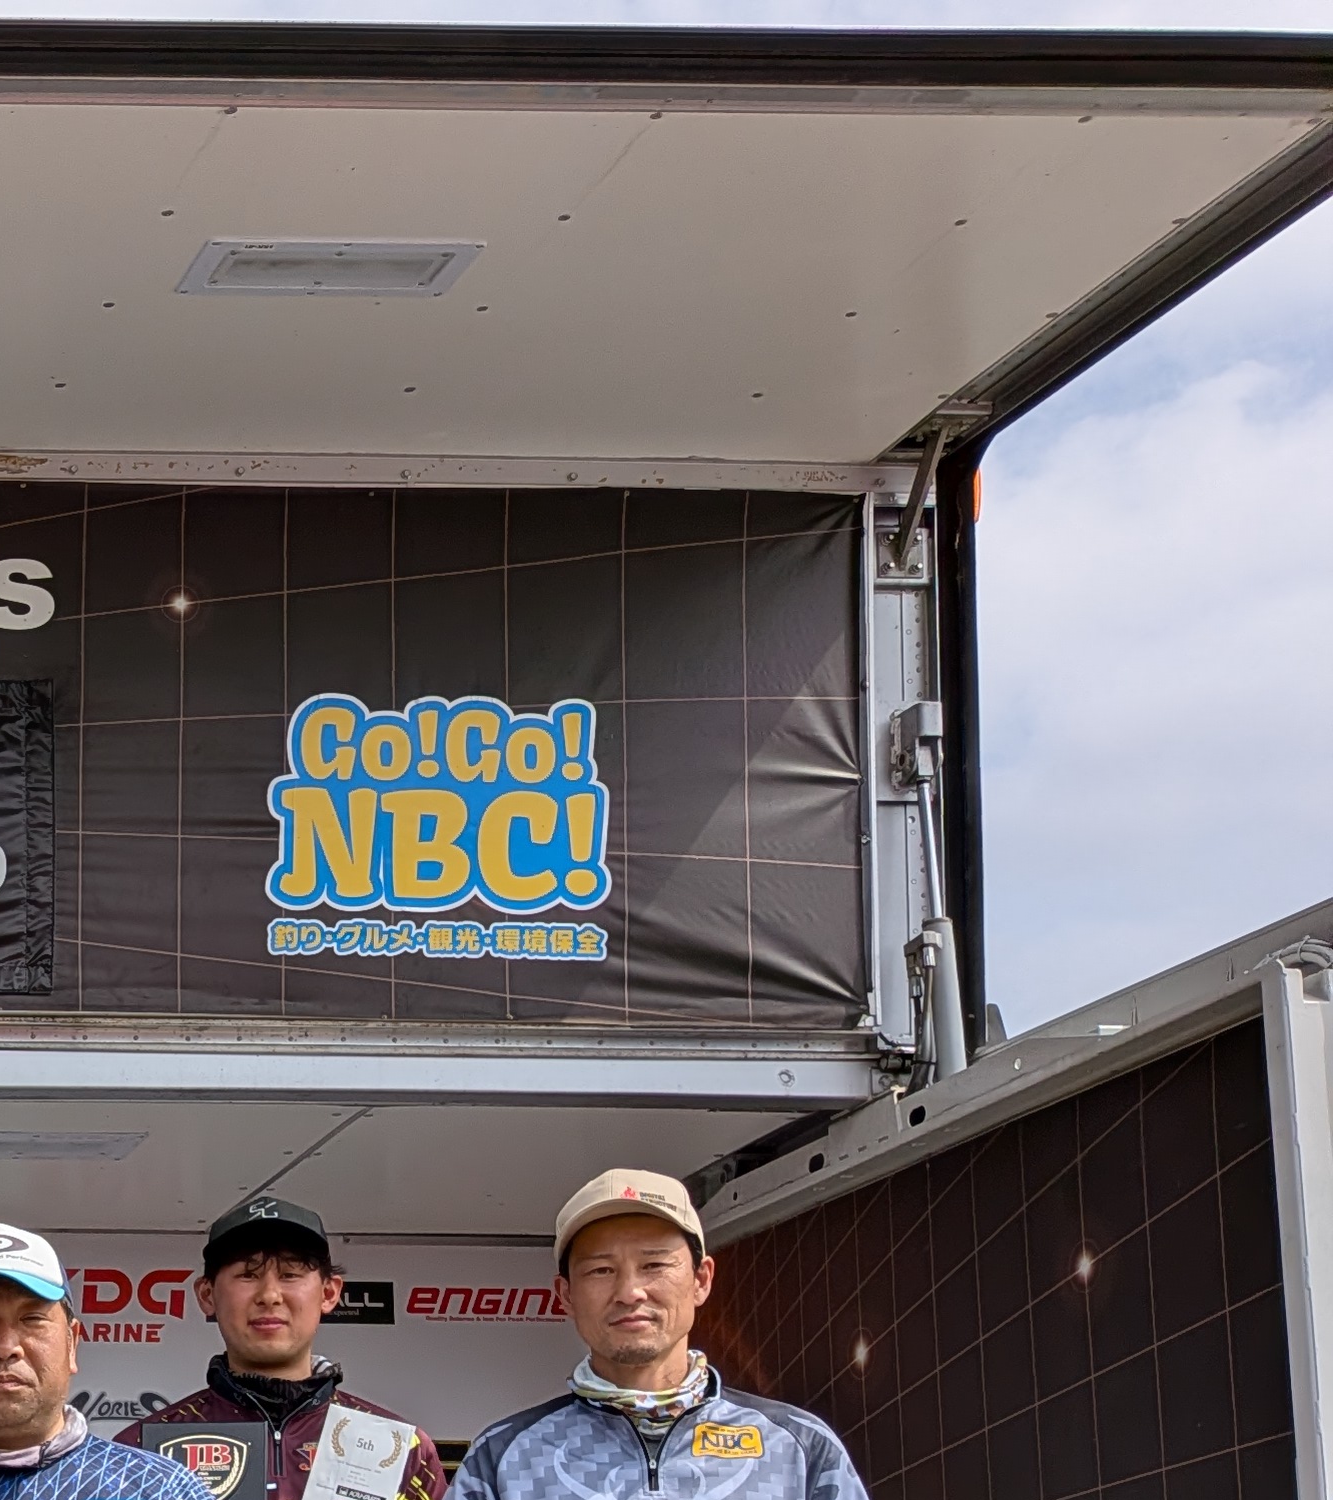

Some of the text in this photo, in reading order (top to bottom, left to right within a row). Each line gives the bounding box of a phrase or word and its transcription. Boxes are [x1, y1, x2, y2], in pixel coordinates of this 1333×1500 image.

[279, 787, 599, 902] NBC!
[356, 1437, 375, 1451] 5th
[698, 1430, 756, 1450] NBC
[182, 1444, 232, 1470] JB
